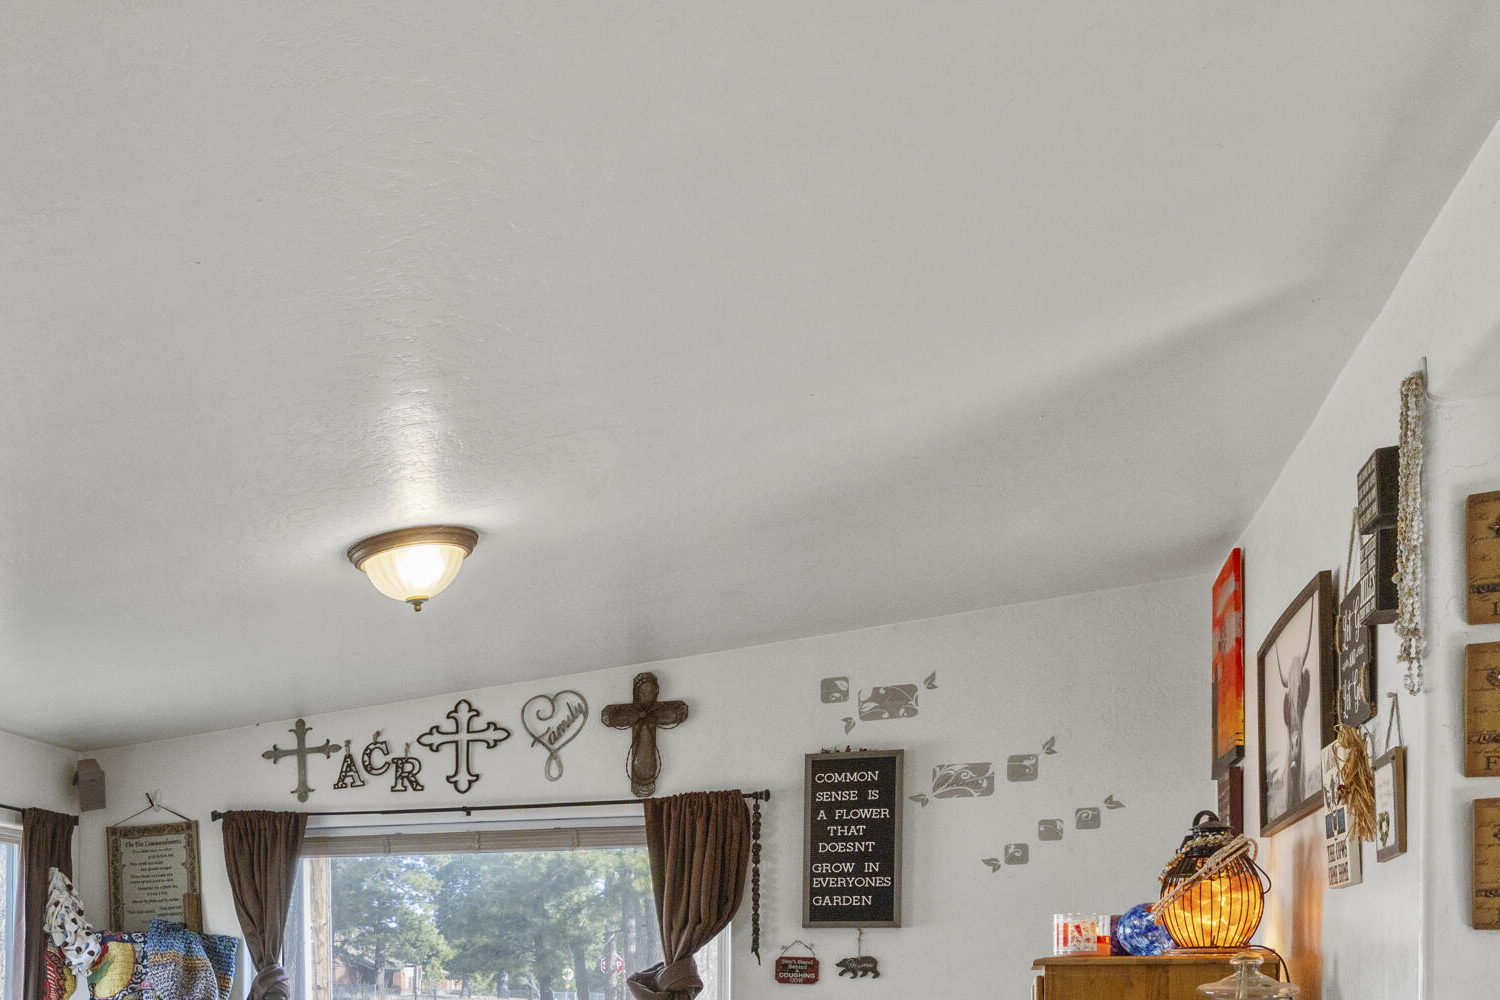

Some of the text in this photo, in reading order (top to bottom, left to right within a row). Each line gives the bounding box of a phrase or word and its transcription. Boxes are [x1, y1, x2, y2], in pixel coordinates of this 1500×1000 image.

[815, 771, 879, 783] COMMON
[815, 789, 879, 802] SENSE IS
[817, 808, 890, 820] A FLOWER
[827, 825, 866, 836] THAT
[818, 842, 876, 853] DOESNT
[812, 862, 880, 873] GROW IN
[812, 876, 891, 888] EVERYONES
[812, 895, 872, 906] GARDEN
